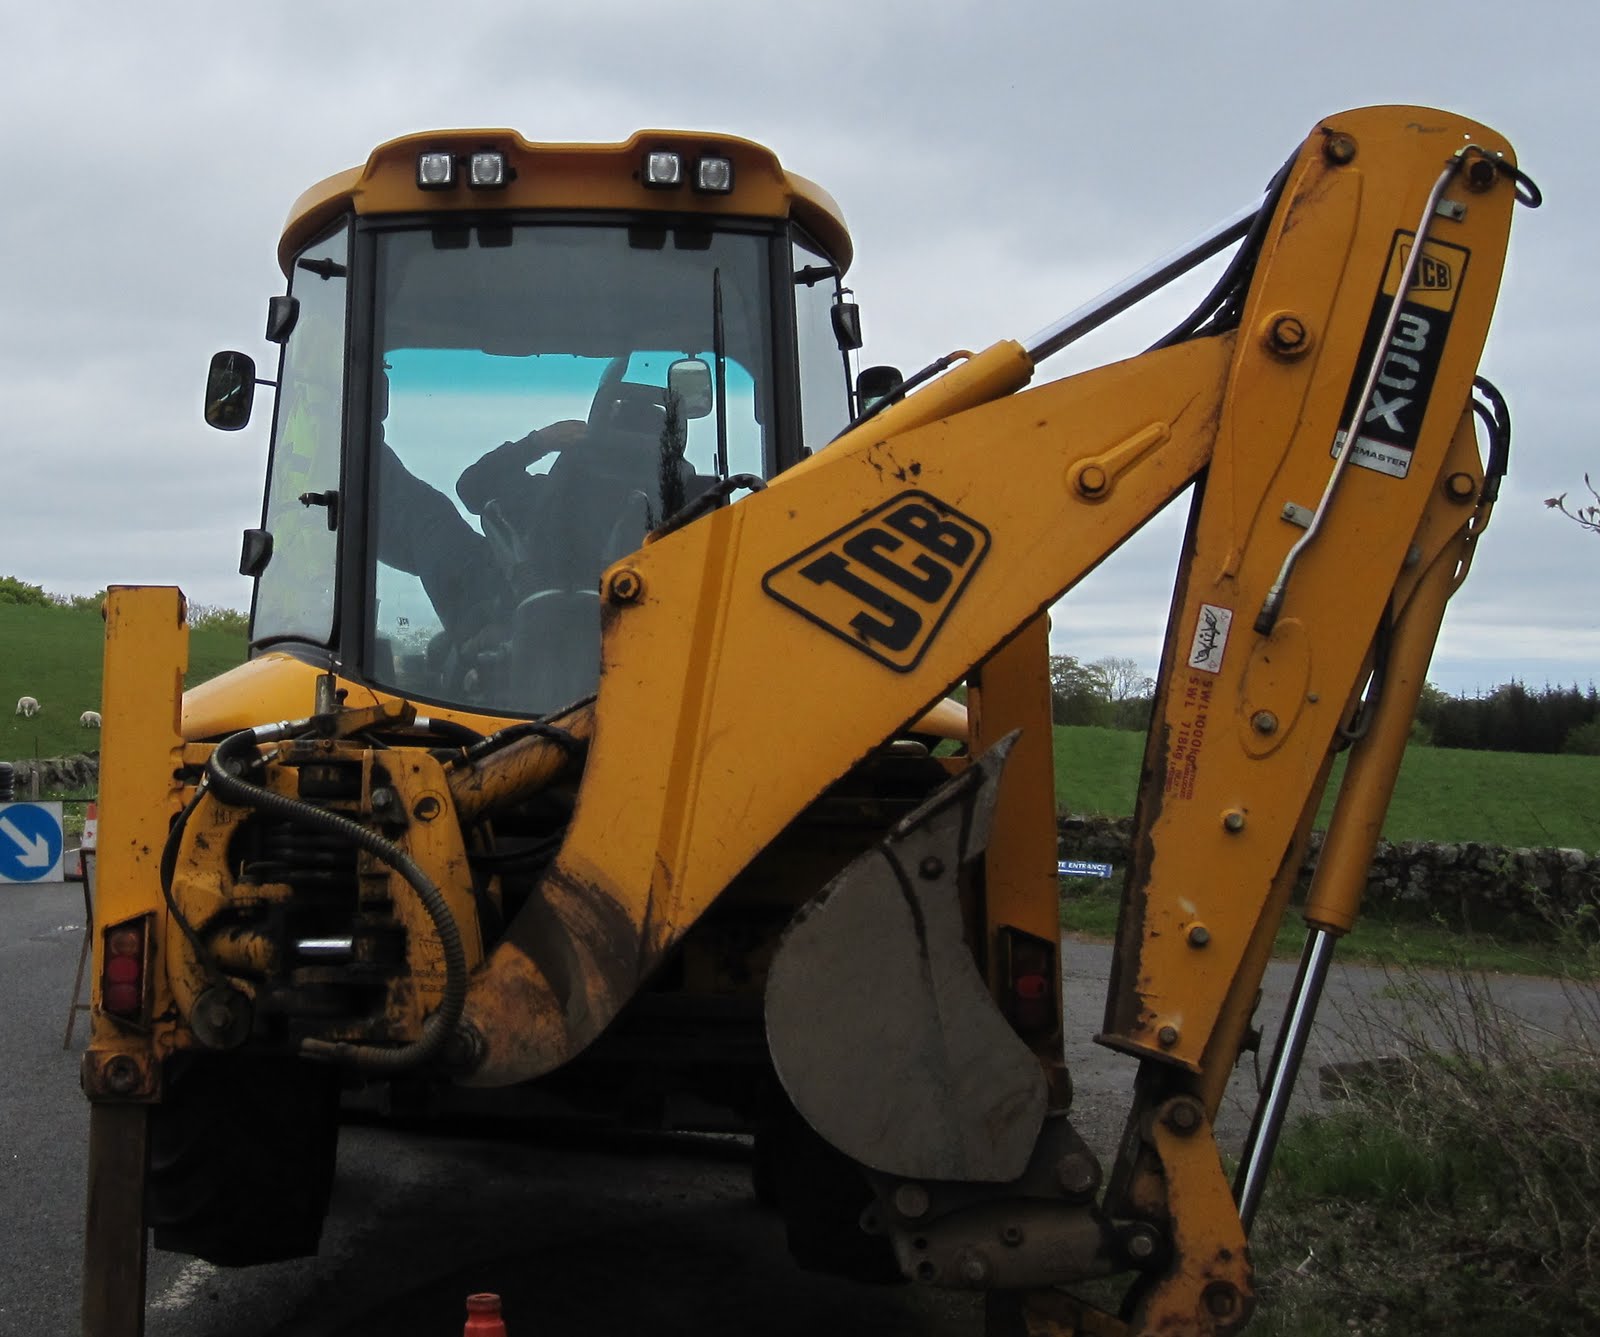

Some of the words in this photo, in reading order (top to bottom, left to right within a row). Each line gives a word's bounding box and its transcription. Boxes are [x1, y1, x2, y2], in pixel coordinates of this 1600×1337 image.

[1364, 314, 1430, 433] 3CX
[1335, 441, 1408, 469] SEMASTER
[798, 503, 976, 652] JCB
[1069, 862, 1106, 870] ENTRANCE
